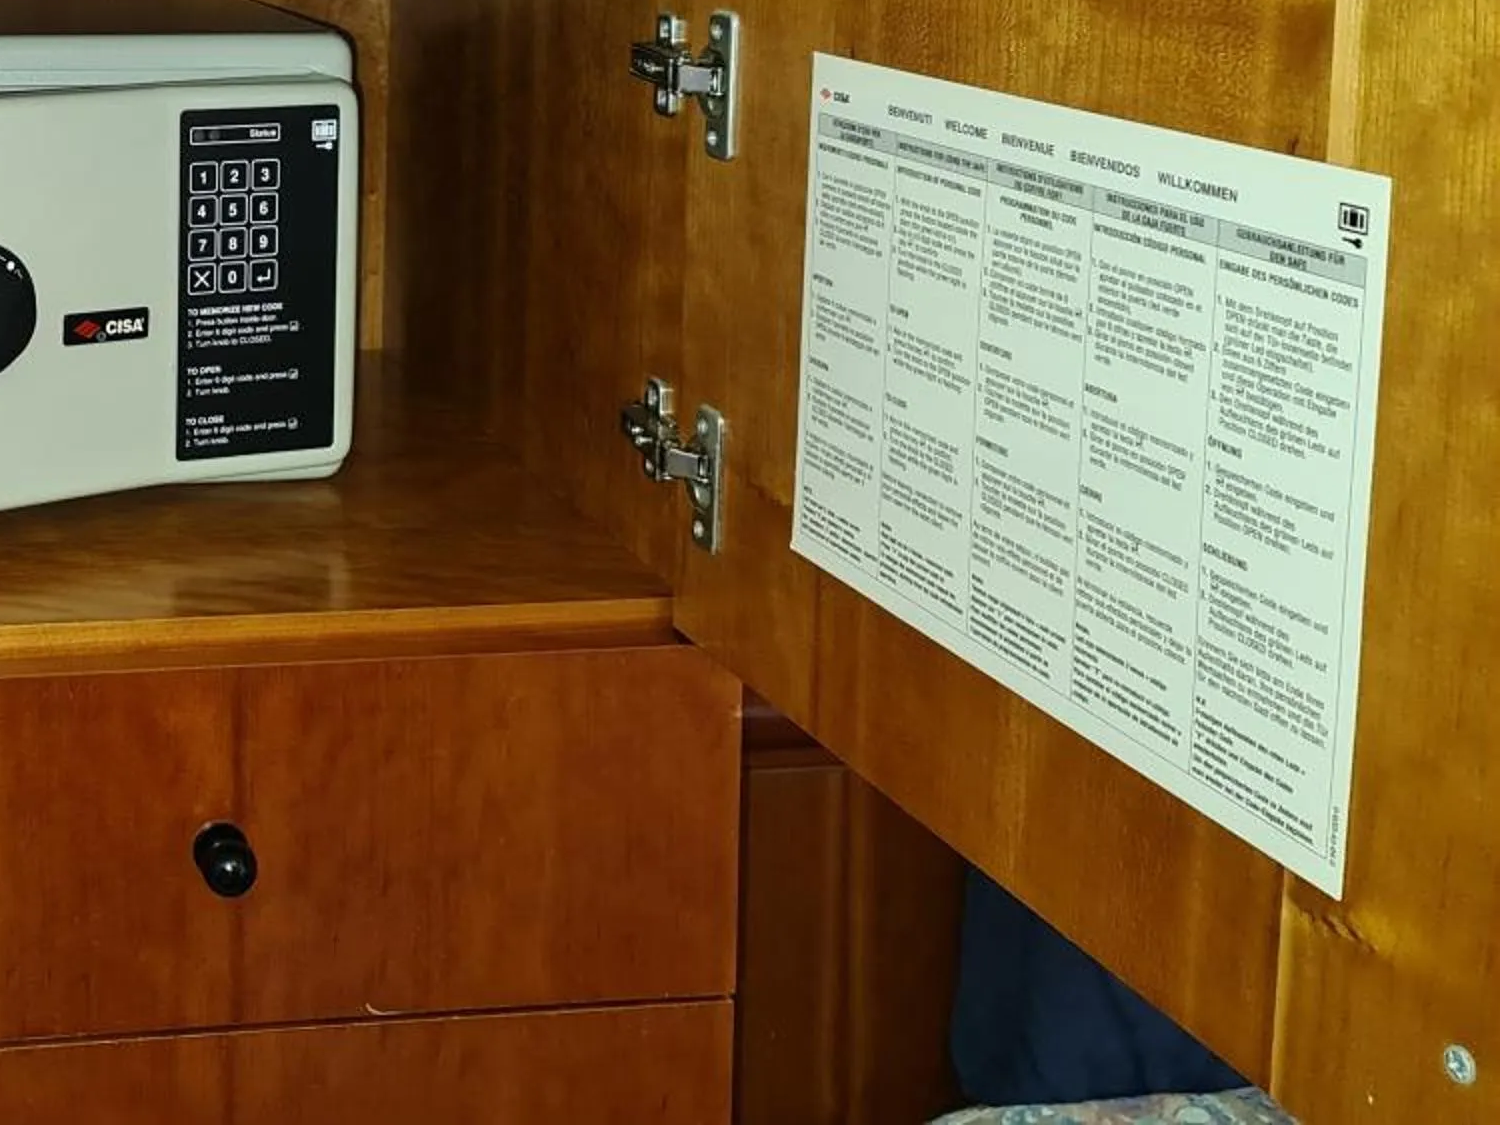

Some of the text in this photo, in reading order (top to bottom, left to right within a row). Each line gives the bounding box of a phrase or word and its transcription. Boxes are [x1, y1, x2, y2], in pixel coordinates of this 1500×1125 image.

[887, 104, 1239, 204] BENVENUTI WELCOME BIENVENUE BIENVENIDOS WILLKOMMEN
[200, 170, 208, 185] 1
[229, 168, 239, 183] 2
[260, 167, 270, 182] 3
[197, 204, 207, 218] 4
[228, 202, 238, 217] 5
[259, 200, 269, 215] 6
[198, 238, 208, 252] 7
[228, 237, 238, 251] 8
[259, 234, 269, 249] 9
[227, 270, 237, 284] 0
[261, 302, 283, 312] CODE
[105, 318, 144, 335] CISA
